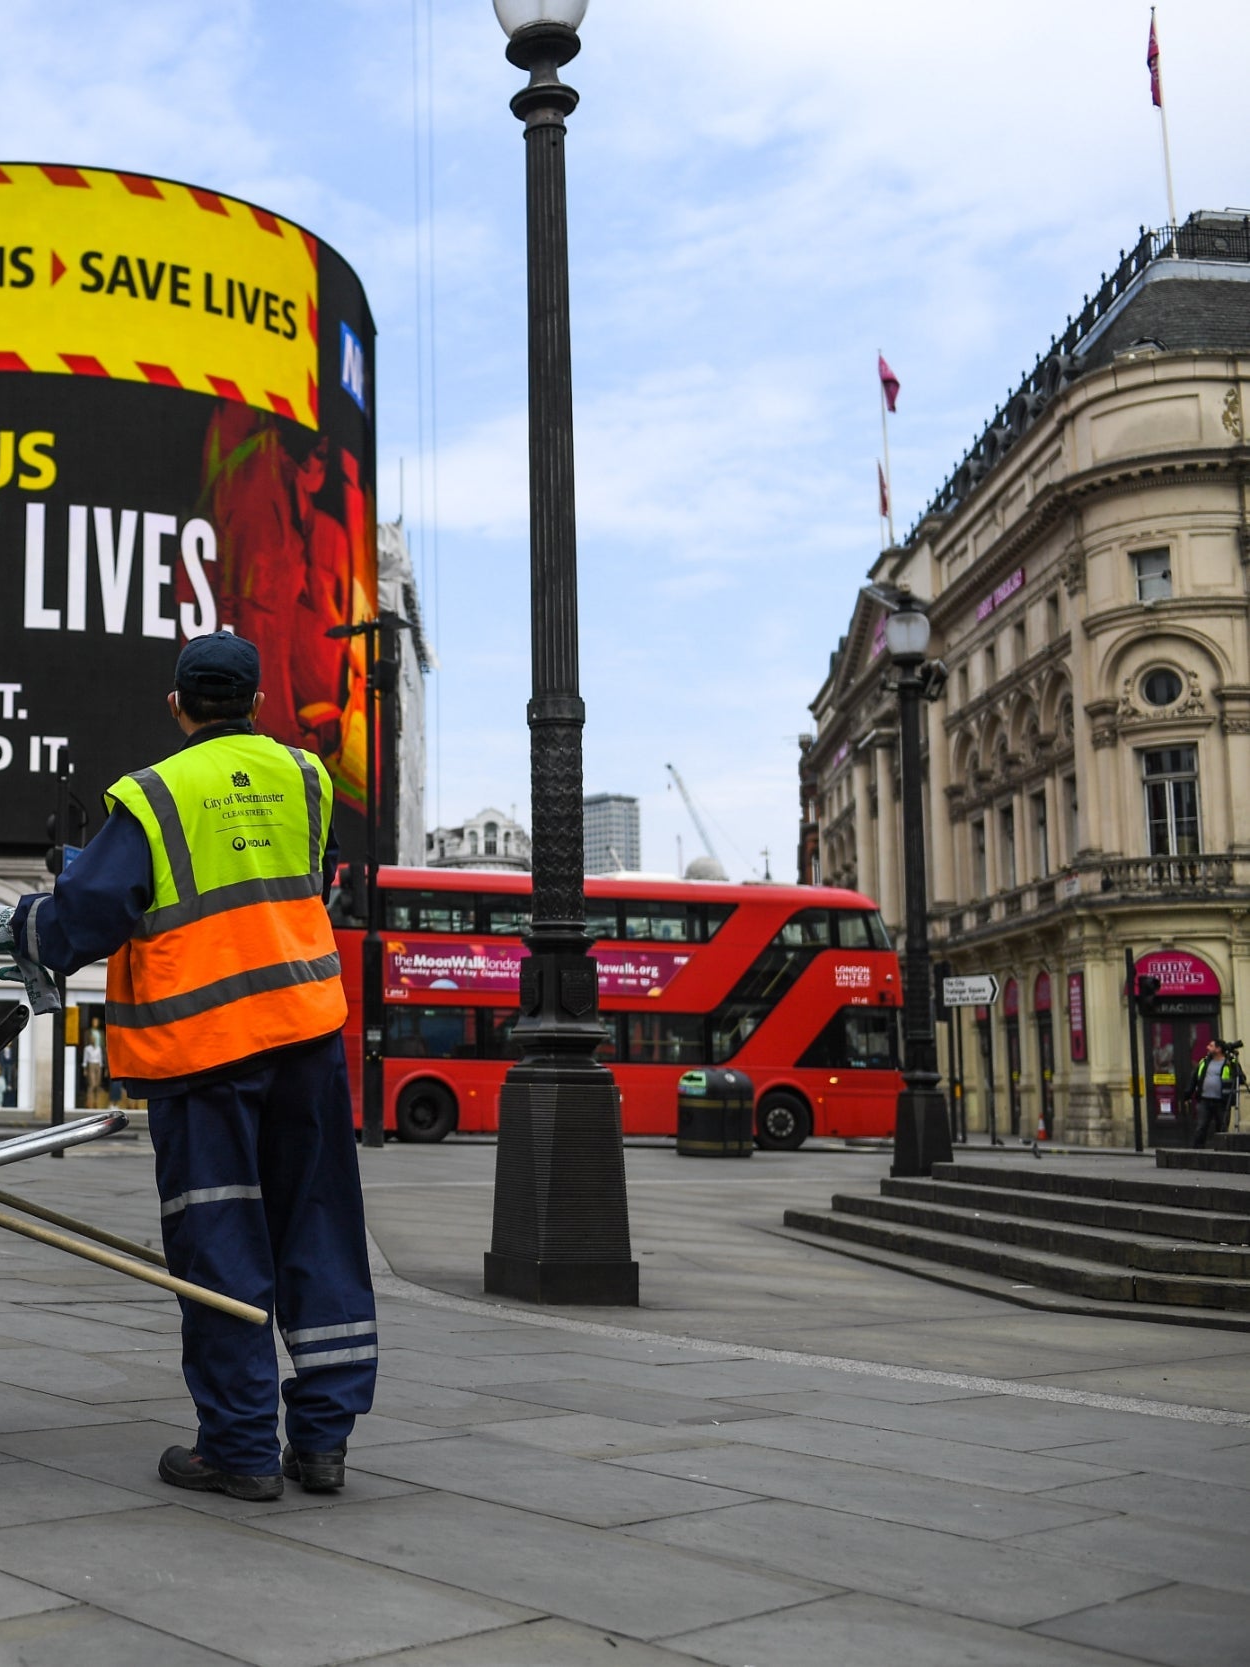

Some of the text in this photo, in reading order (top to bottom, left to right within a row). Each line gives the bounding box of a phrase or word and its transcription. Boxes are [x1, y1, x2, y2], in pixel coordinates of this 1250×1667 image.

[80, 250, 191, 308] SAVE
[204, 272, 298, 341] LIVES
[29, 735, 74, 774] IT.
[203, 792, 284, 810] City of Westminster
[245, 808, 273, 817] STREETS
[596, 961, 659, 978] hewalk.org
[1148, 961, 1192, 973] BODY
[1144, 972, 1205, 984] ORLDS
